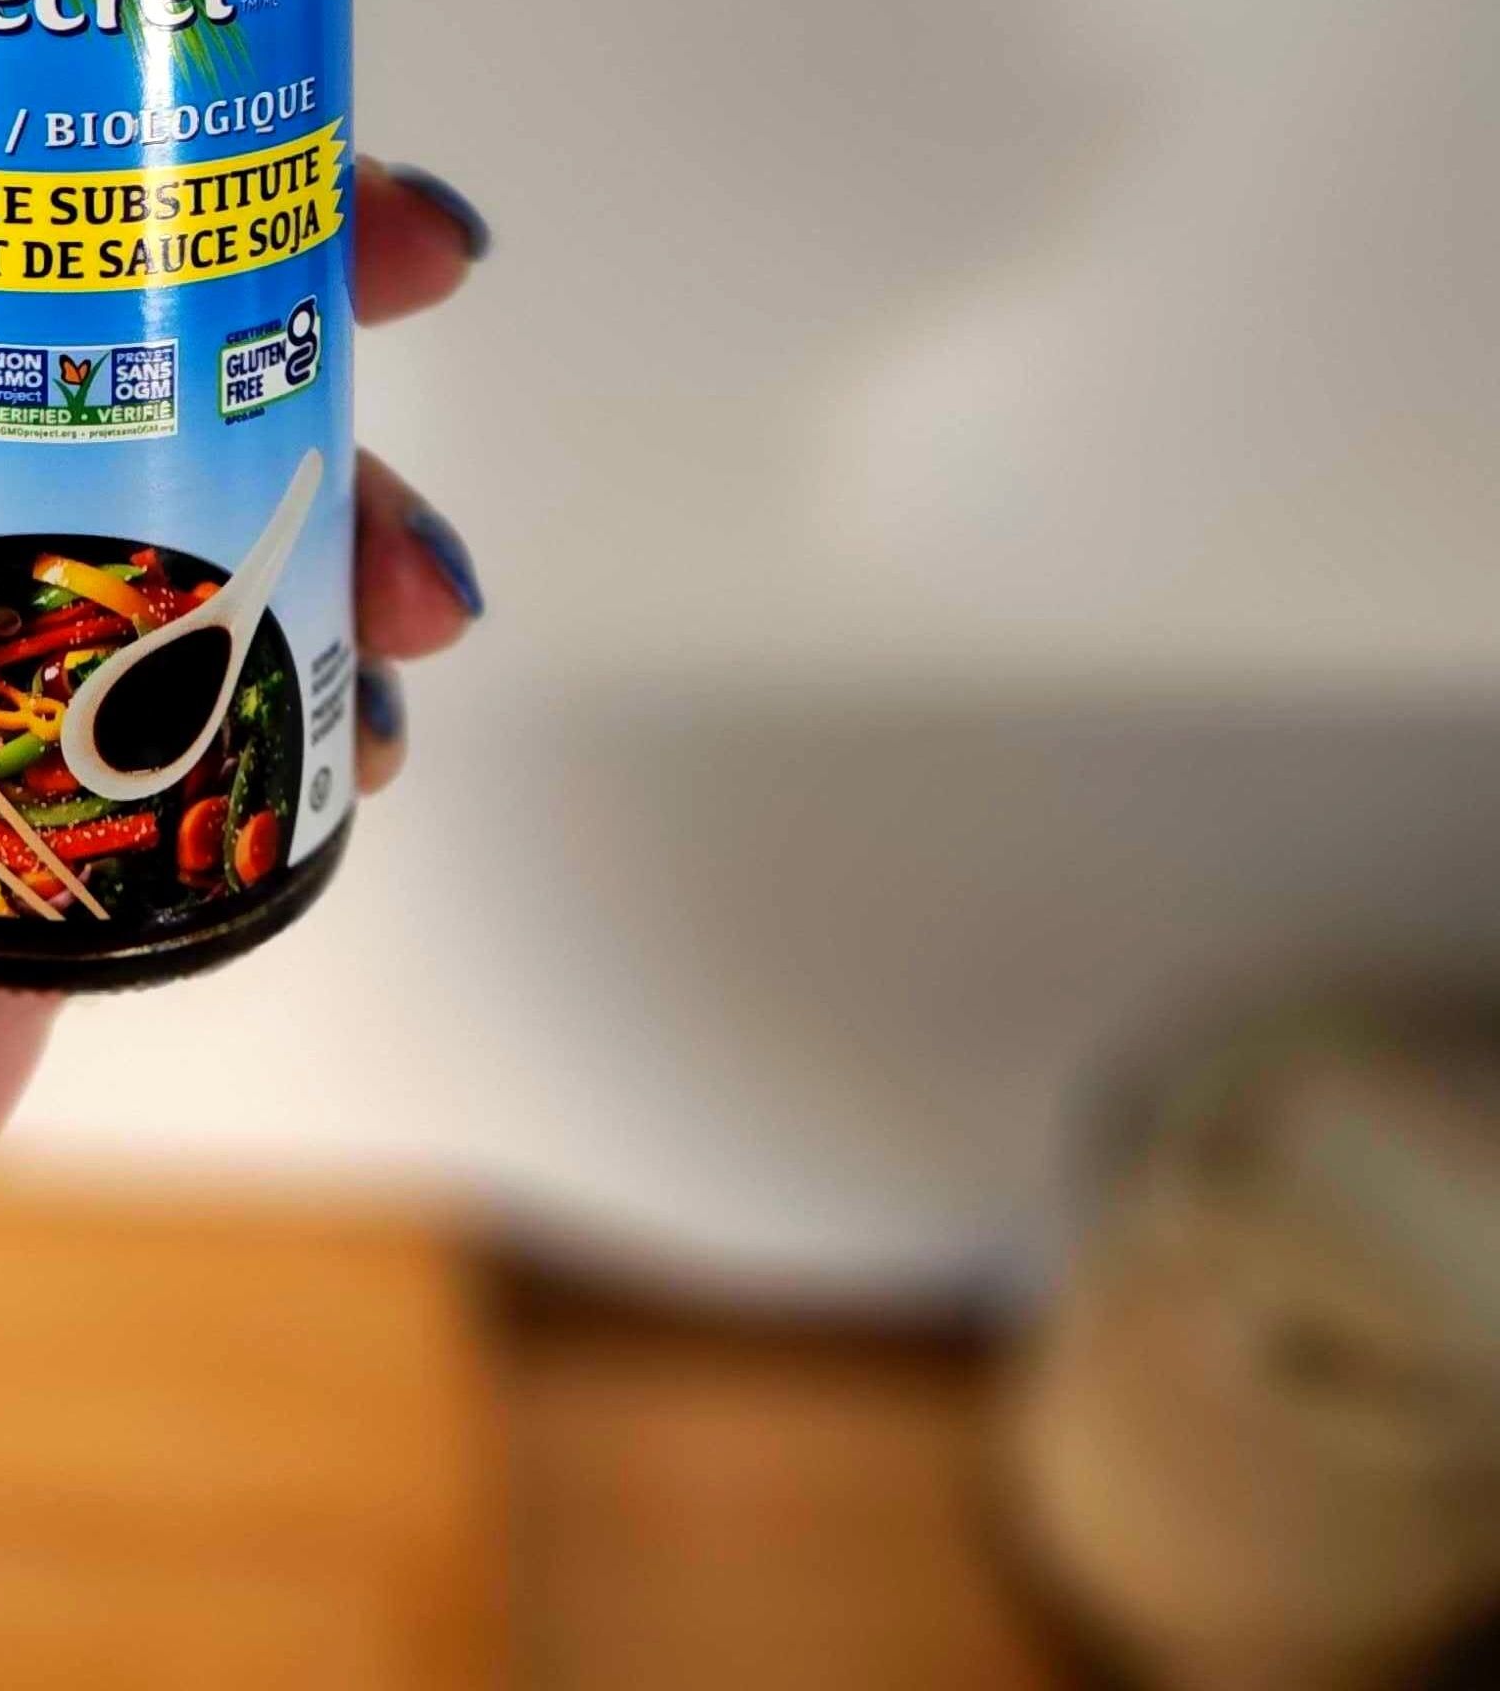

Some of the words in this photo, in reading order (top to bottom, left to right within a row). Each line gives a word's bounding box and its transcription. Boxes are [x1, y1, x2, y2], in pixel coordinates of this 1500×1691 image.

[43, 76, 317, 148] BIOLOGIQUE
[50, 145, 321, 226] SUBSTITUTE
[23, 240, 85, 280] DE
[98, 224, 239, 280] SAUCE
[249, 198, 322, 255] SOJA
[116, 362, 172, 382] SANS
[226, 338, 287, 379] GLUTEN
[115, 379, 172, 401] OGM
[226, 373, 264, 407] FREE
